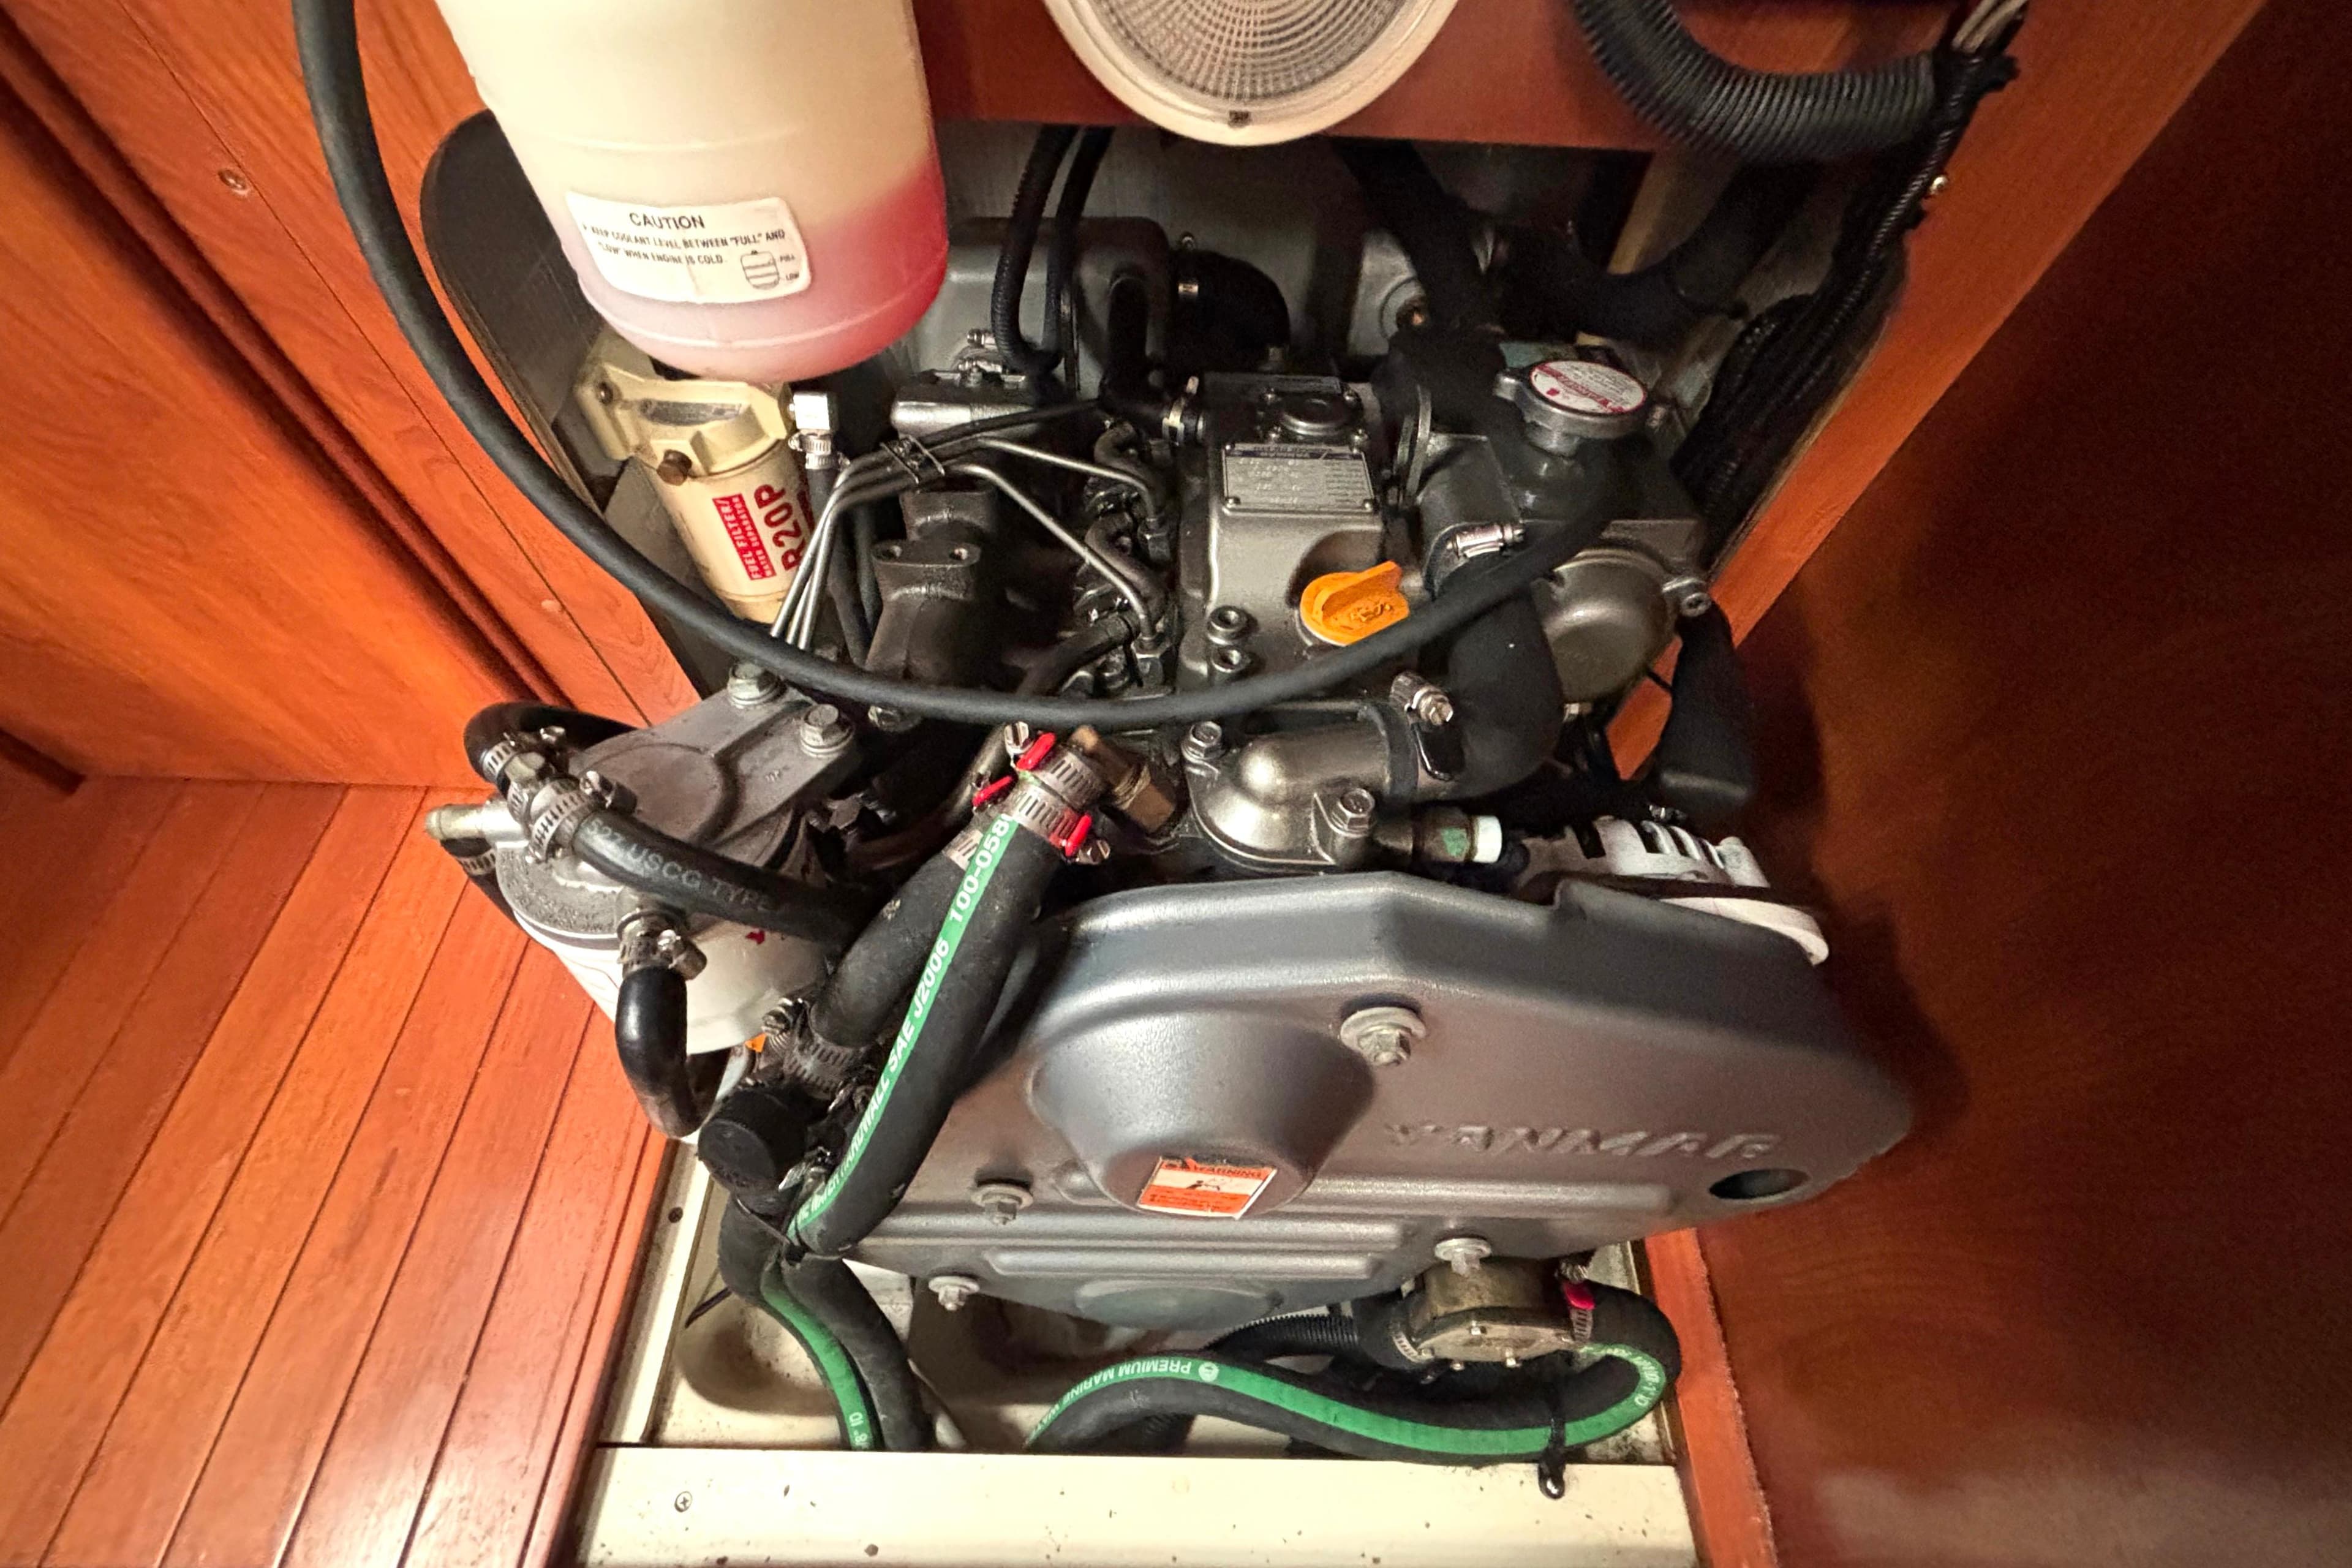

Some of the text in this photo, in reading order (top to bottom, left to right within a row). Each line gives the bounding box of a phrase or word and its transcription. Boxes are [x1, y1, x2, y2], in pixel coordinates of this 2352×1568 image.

[629, 212, 705, 230] CAUTION
[611, 230, 650, 244] COOLANT
[653, 236, 681, 249] LEVEL
[682, 236, 728, 249] BETWEEN
[730, 233, 762, 246] "FULL"
[766, 228, 785, 242] AND
[754, 484, 805, 570] R20P
[742, 551, 763, 579] FUEL
[627, 843, 702, 888] USCG
[888, 1018, 915, 1073] SAE
[913, 937, 949, 1019] J2006
[1117, 1359, 1193, 1378] PREMIUM
[1062, 1367, 1115, 1404] MARINE
